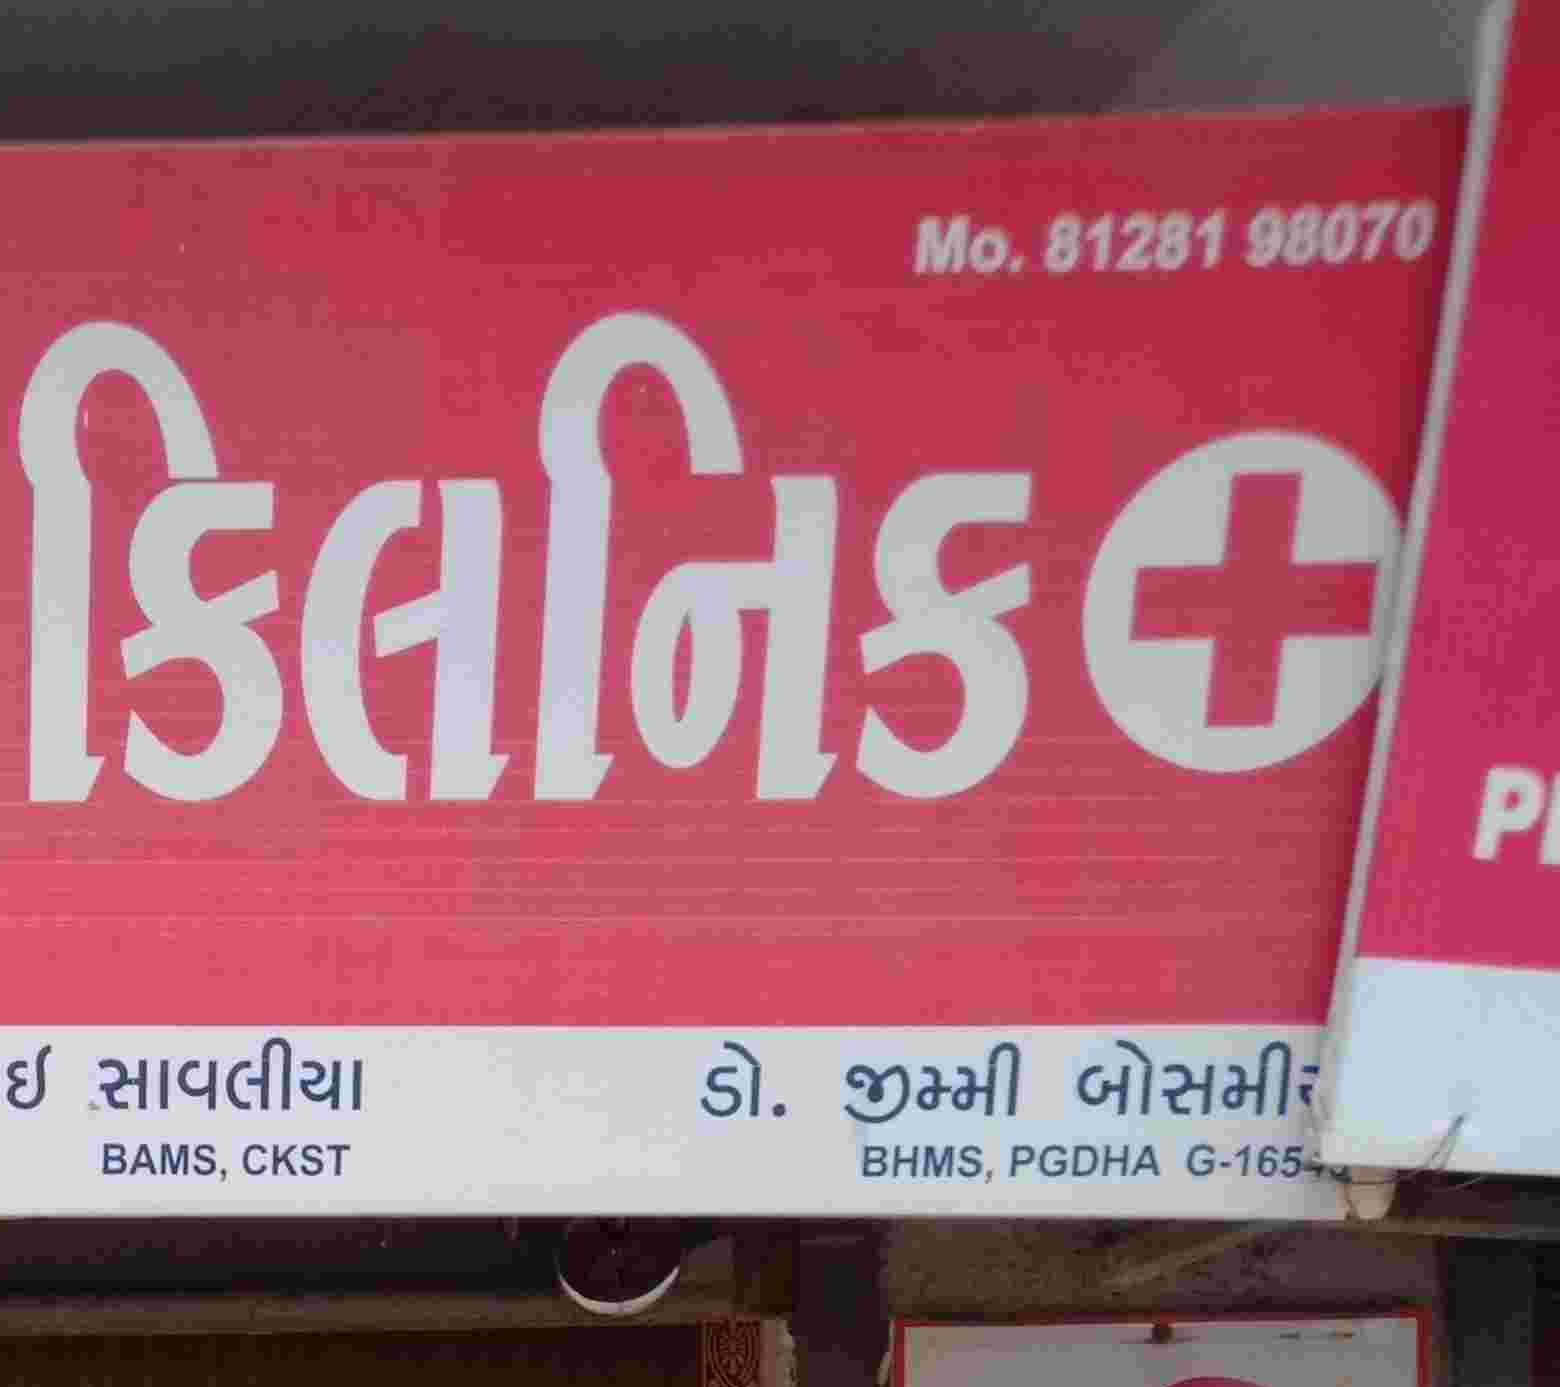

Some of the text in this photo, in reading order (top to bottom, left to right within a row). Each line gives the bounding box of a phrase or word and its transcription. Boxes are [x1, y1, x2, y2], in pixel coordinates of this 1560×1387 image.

[914, 198, 1437, 275] Mo. 81281 98070
[18, 312, 1033, 803] કિલનિક
[97, 1038, 362, 1112] સાવલીયા
[700, 1041, 787, 1118] ડો.
[844, 1041, 1022, 1123] જીમ્મી
[101, 1144, 351, 1183] BAMS, CKST
[860, 1145, 993, 1184] BHMS,
[1009, 1144, 1161, 1178] PGDHA
